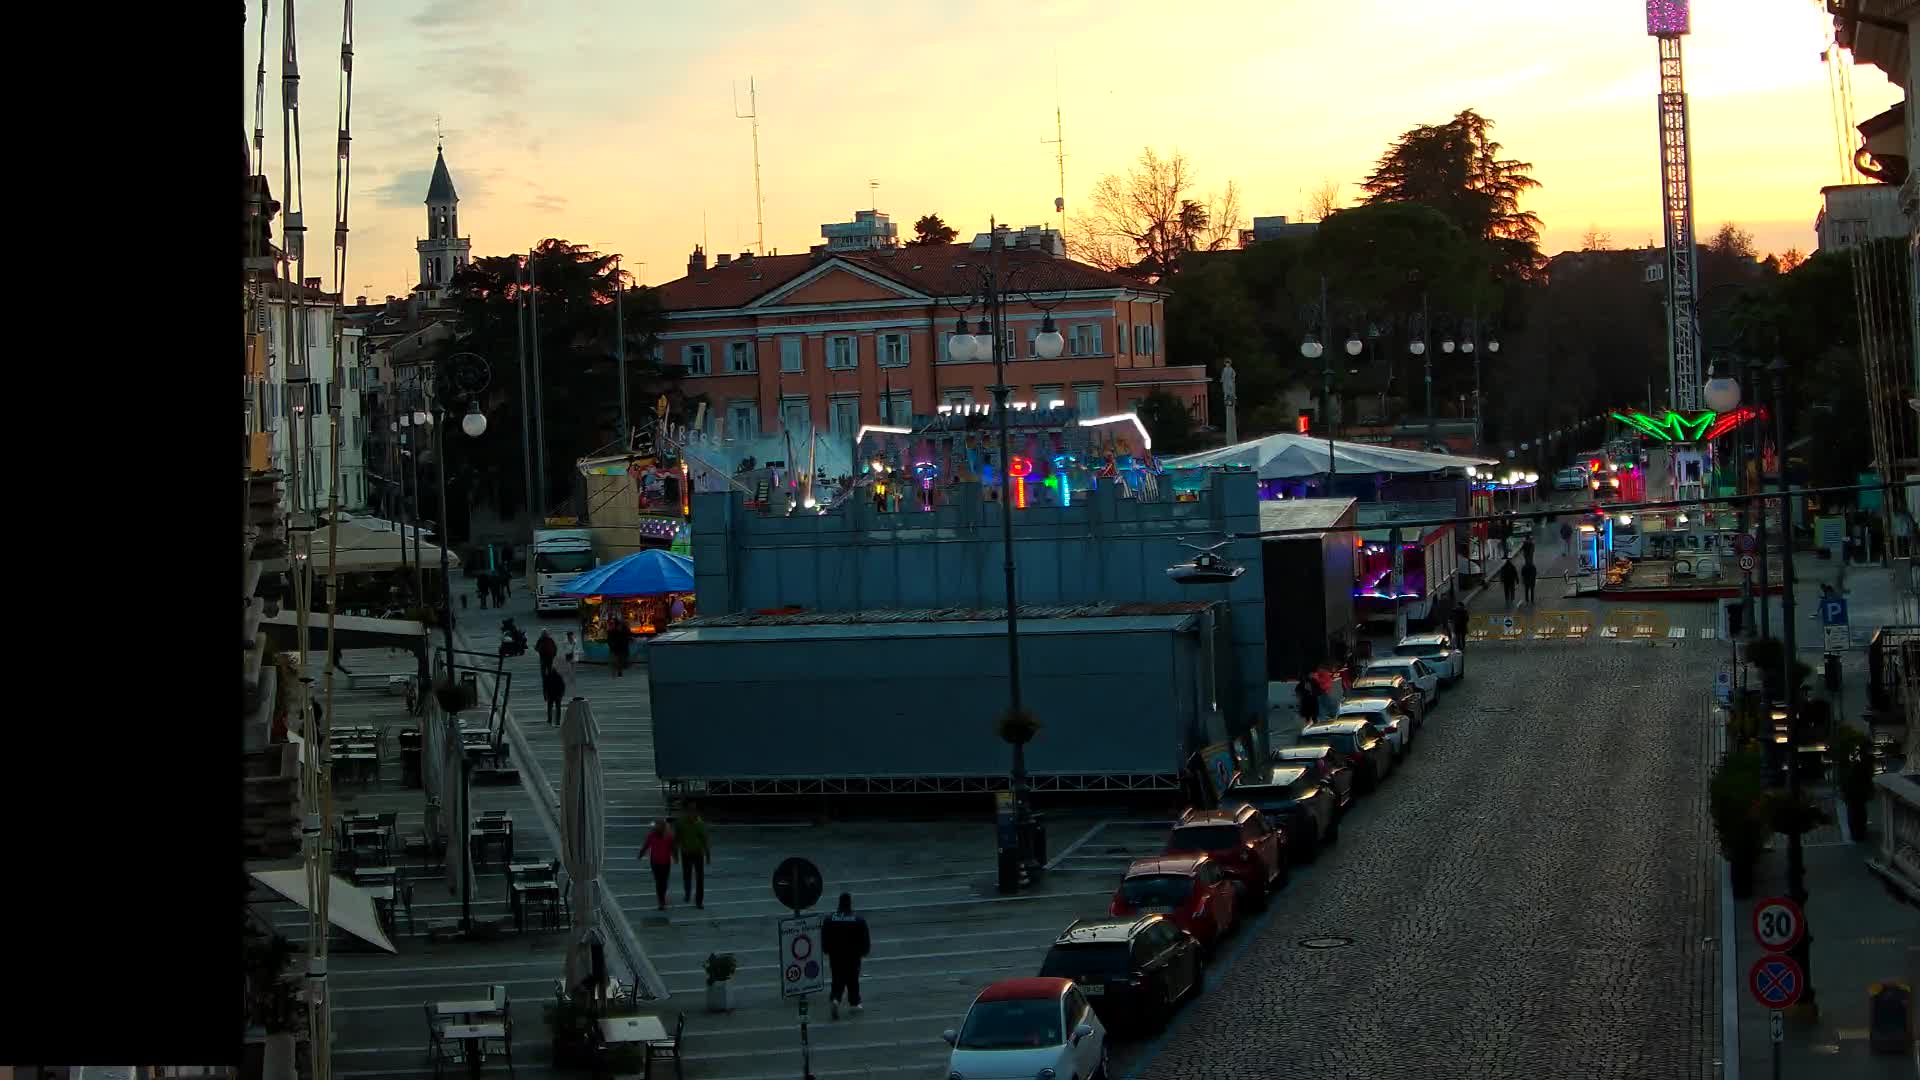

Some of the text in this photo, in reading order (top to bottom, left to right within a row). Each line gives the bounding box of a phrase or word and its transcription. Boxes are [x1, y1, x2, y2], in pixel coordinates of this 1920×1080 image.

[1742, 558, 1753, 567] 20
[1827, 602, 1841, 622] P
[1762, 912, 1791, 937] 30
